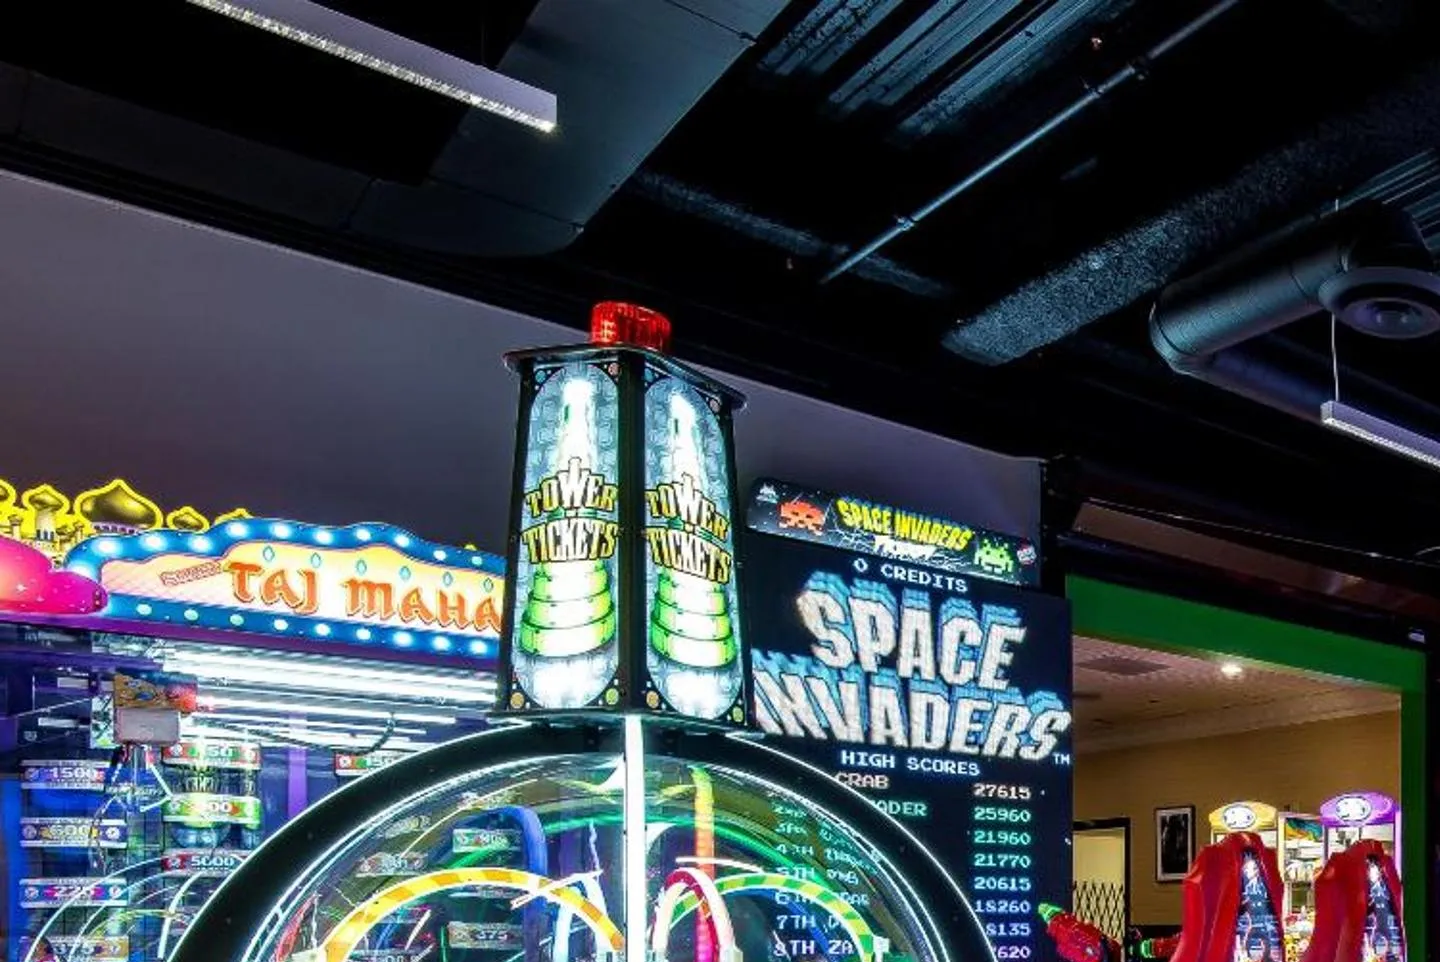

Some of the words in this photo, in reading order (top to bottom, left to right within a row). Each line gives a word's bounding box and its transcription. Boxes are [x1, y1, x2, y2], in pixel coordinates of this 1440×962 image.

[524, 456, 618, 517] TOWER
[645, 471, 730, 541] TOWER
[522, 516, 619, 564] TICKETS
[837, 498, 894, 535] SPACE
[893, 509, 974, 551] INVADERS
[645, 525, 731, 584] TICKETS
[853, 557, 868, 573] 0
[880, 563, 969, 593] CREDITS
[223, 561, 321, 615] TAJ
[340, 577, 502, 632] MAHA
[797, 572, 1027, 690] SPACE
[751, 650, 1072, 762] INVADERS
[841, 753, 895, 770] HIGH
[907, 758, 981, 777] SCORES
[835, 772, 889, 789] CRAB
[973, 783, 1032, 800] 27615
[870, 799, 928, 817] ADER
[973, 807, 1032, 822] 25960
[973, 830, 1032, 845] 21960
[973, 853, 1032, 869] 21770
[974, 876, 1032, 892] 20615
[974, 900, 1032, 914] 18260
[776, 914, 816, 930] 7TH
[986, 922, 1032, 937] 8135
[773, 940, 816, 957] 8TH
[993, 944, 1032, 959] 620
